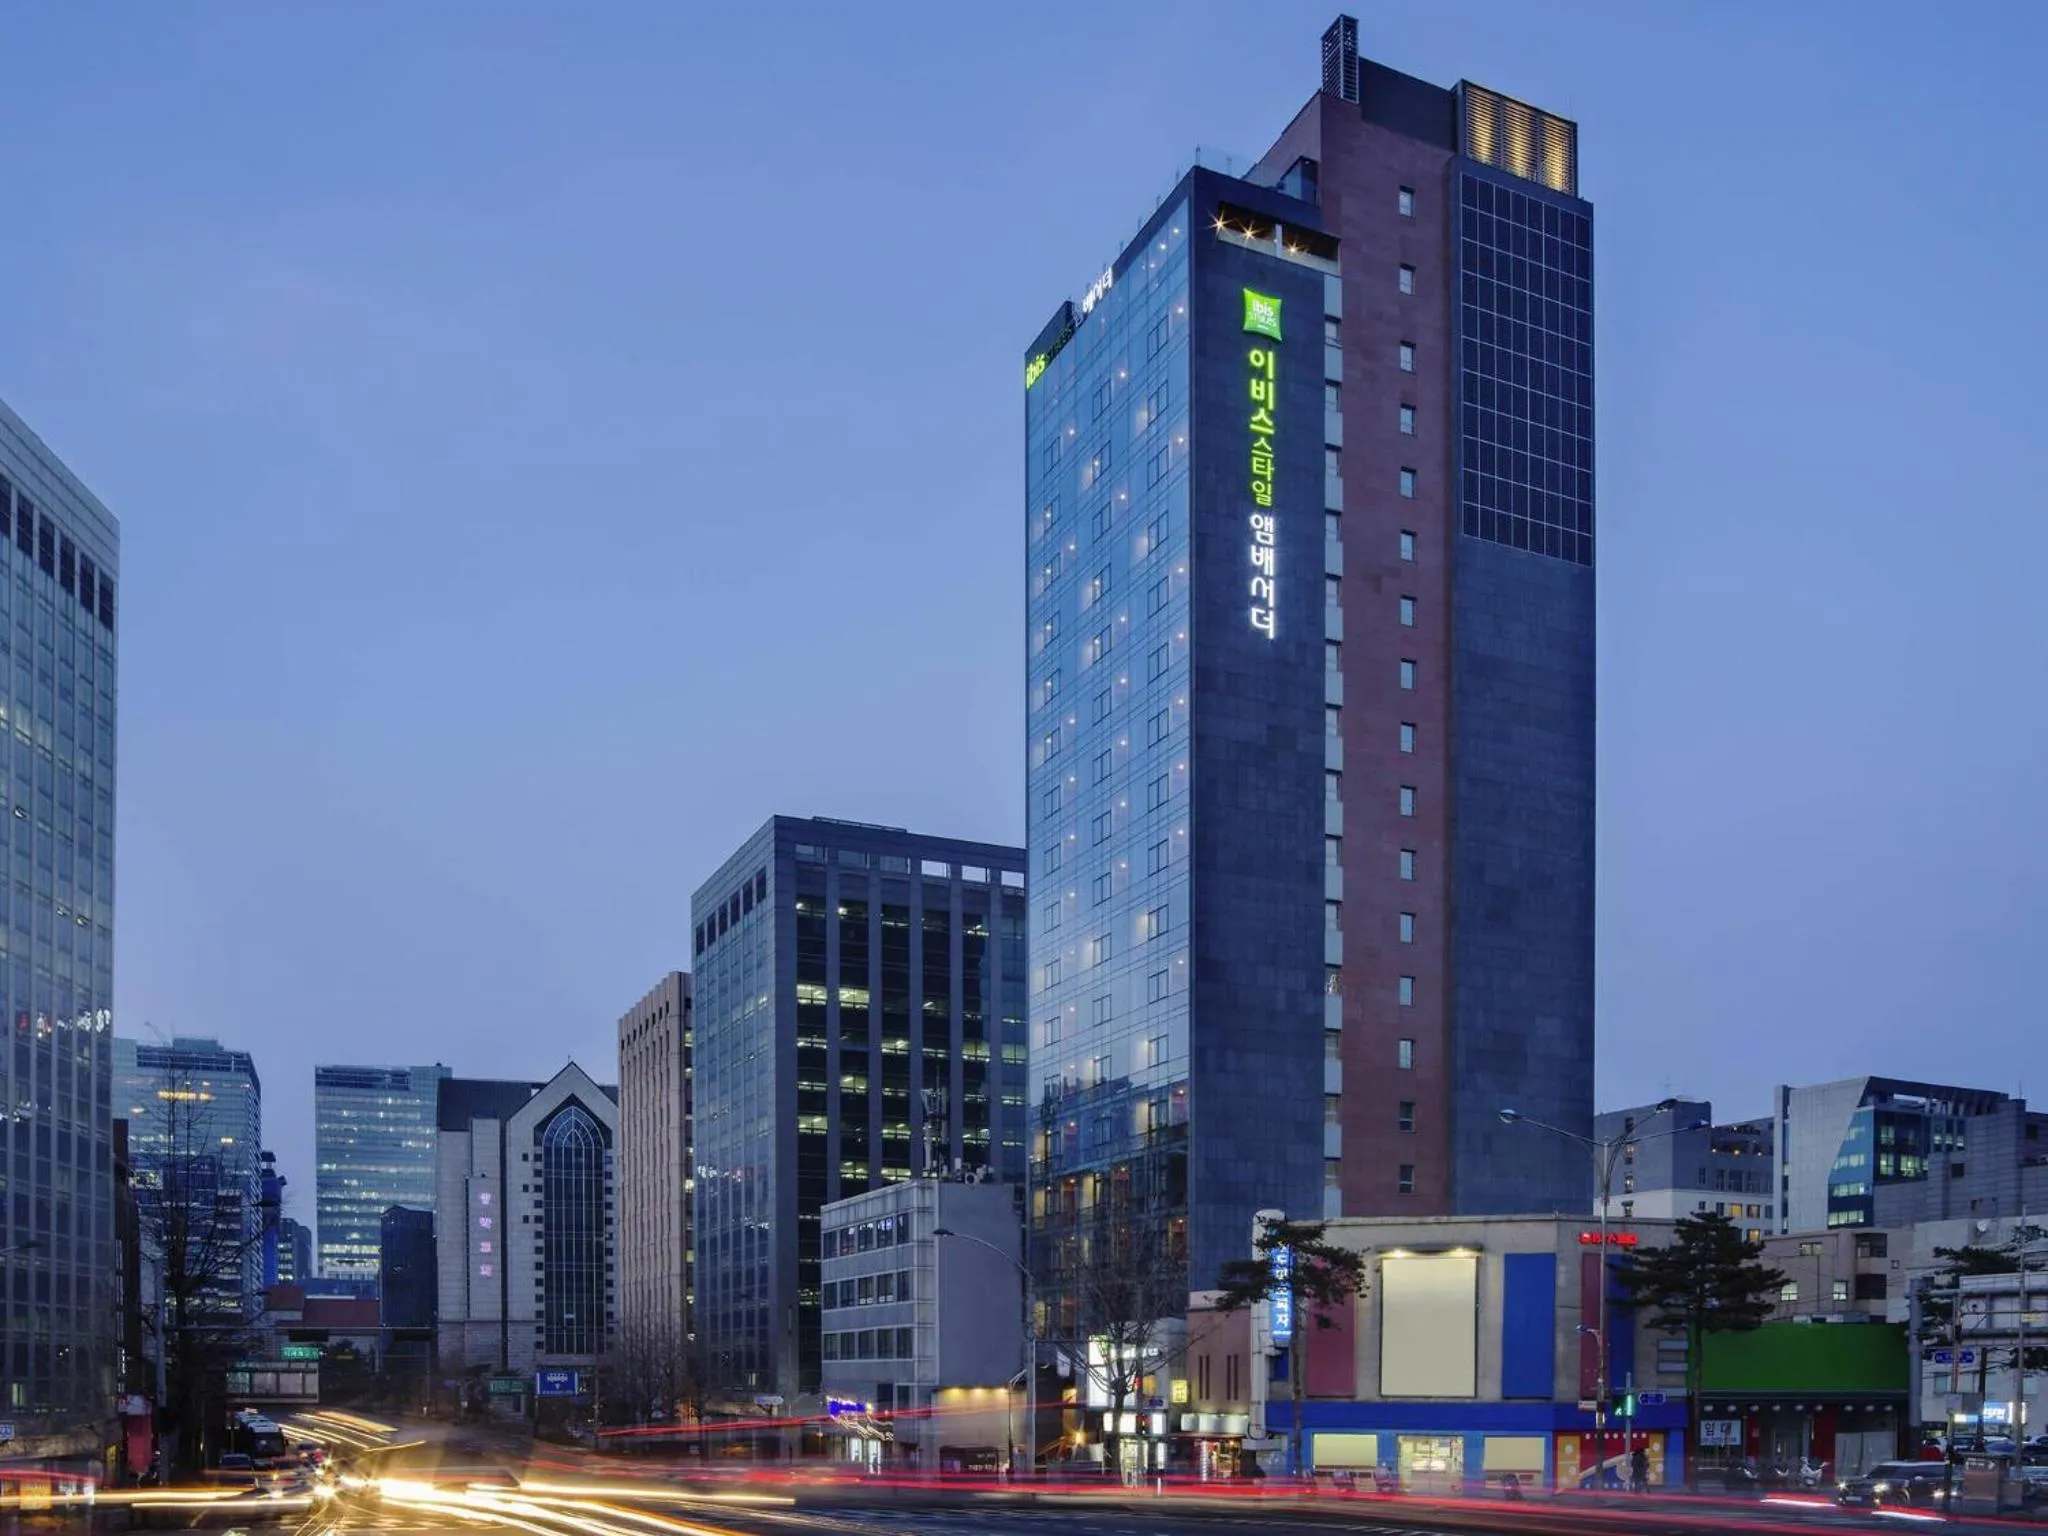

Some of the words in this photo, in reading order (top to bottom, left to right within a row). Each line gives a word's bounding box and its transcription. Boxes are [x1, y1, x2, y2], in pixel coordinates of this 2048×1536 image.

[1252, 299, 1275, 318] ibis
[1249, 348, 1275, 435] 이비스
[1251, 436, 1275, 507] 스타일
[1249, 513, 1275, 639] 앰배서더
